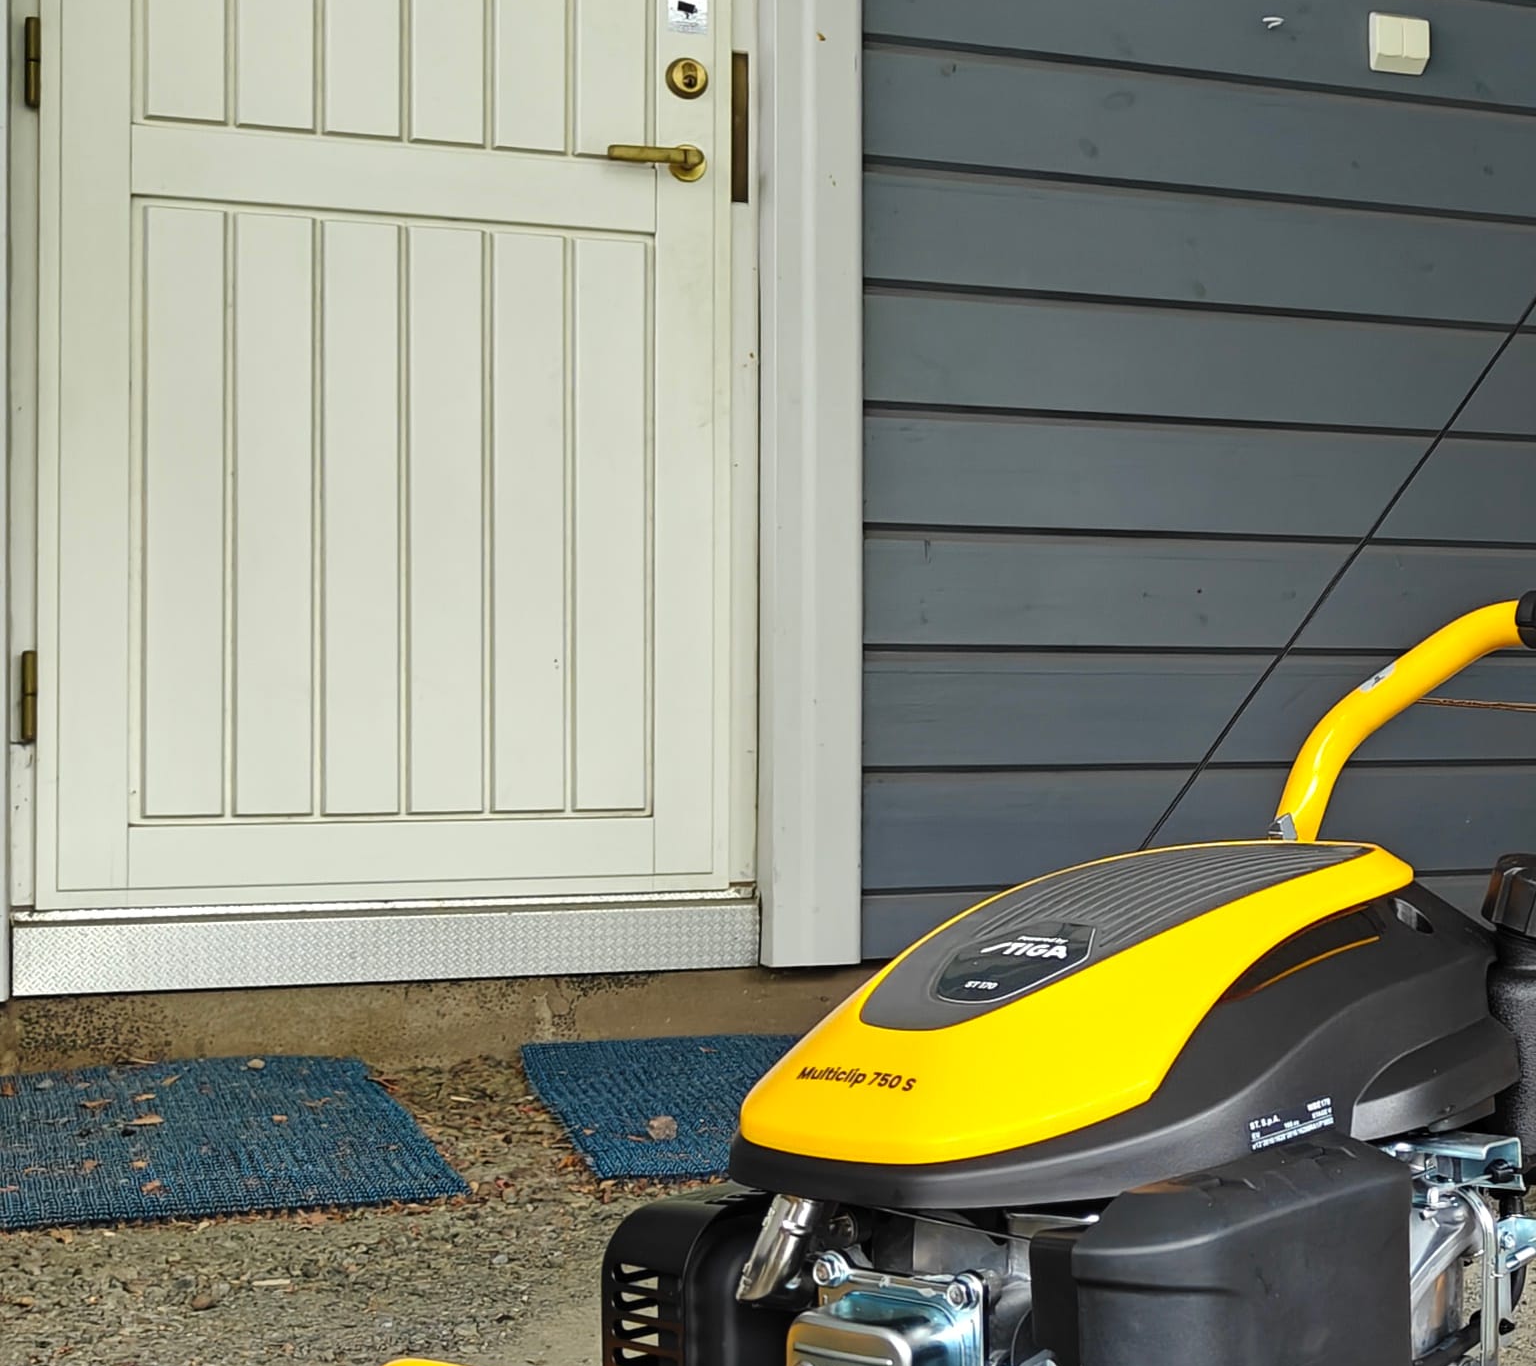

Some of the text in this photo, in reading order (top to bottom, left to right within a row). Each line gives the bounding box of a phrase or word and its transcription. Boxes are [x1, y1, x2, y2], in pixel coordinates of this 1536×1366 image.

[980, 941, 1068, 960] STIGA
[964, 980, 981, 988] ST
[796, 1066, 917, 1092] Multiclip 750 S
